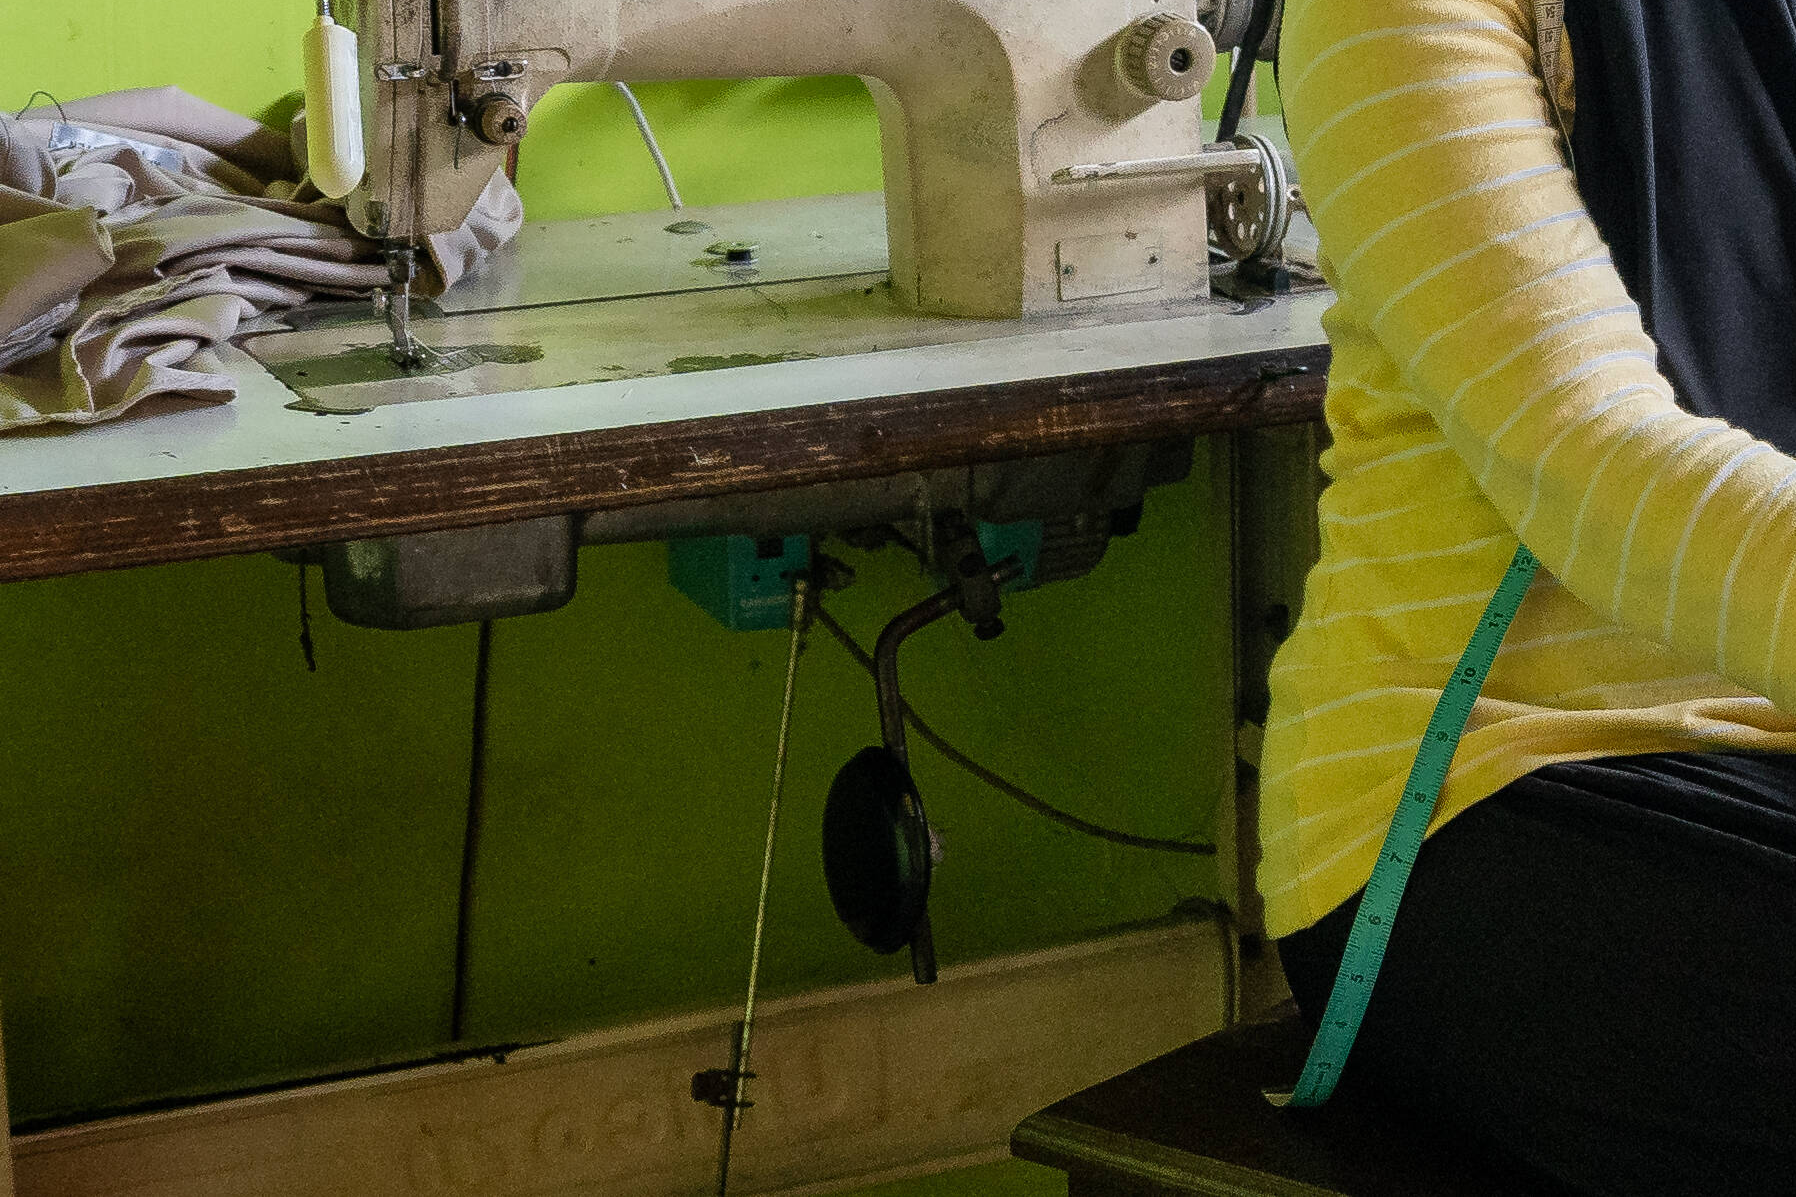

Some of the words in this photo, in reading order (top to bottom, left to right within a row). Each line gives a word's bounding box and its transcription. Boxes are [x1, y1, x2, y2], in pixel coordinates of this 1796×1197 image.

[1545, 5, 1555, 19] 54
[1350, 973, 1364, 984] 5
[1368, 914, 1381, 925] 6
[1389, 852, 1403, 864] 7
[1414, 792, 1426, 803] 8
[1436, 731, 1448, 742] 9
[1460, 667, 1476, 685] 10
[1489, 611, 1504, 628] 11
[1517, 555, 1532, 573] 12
